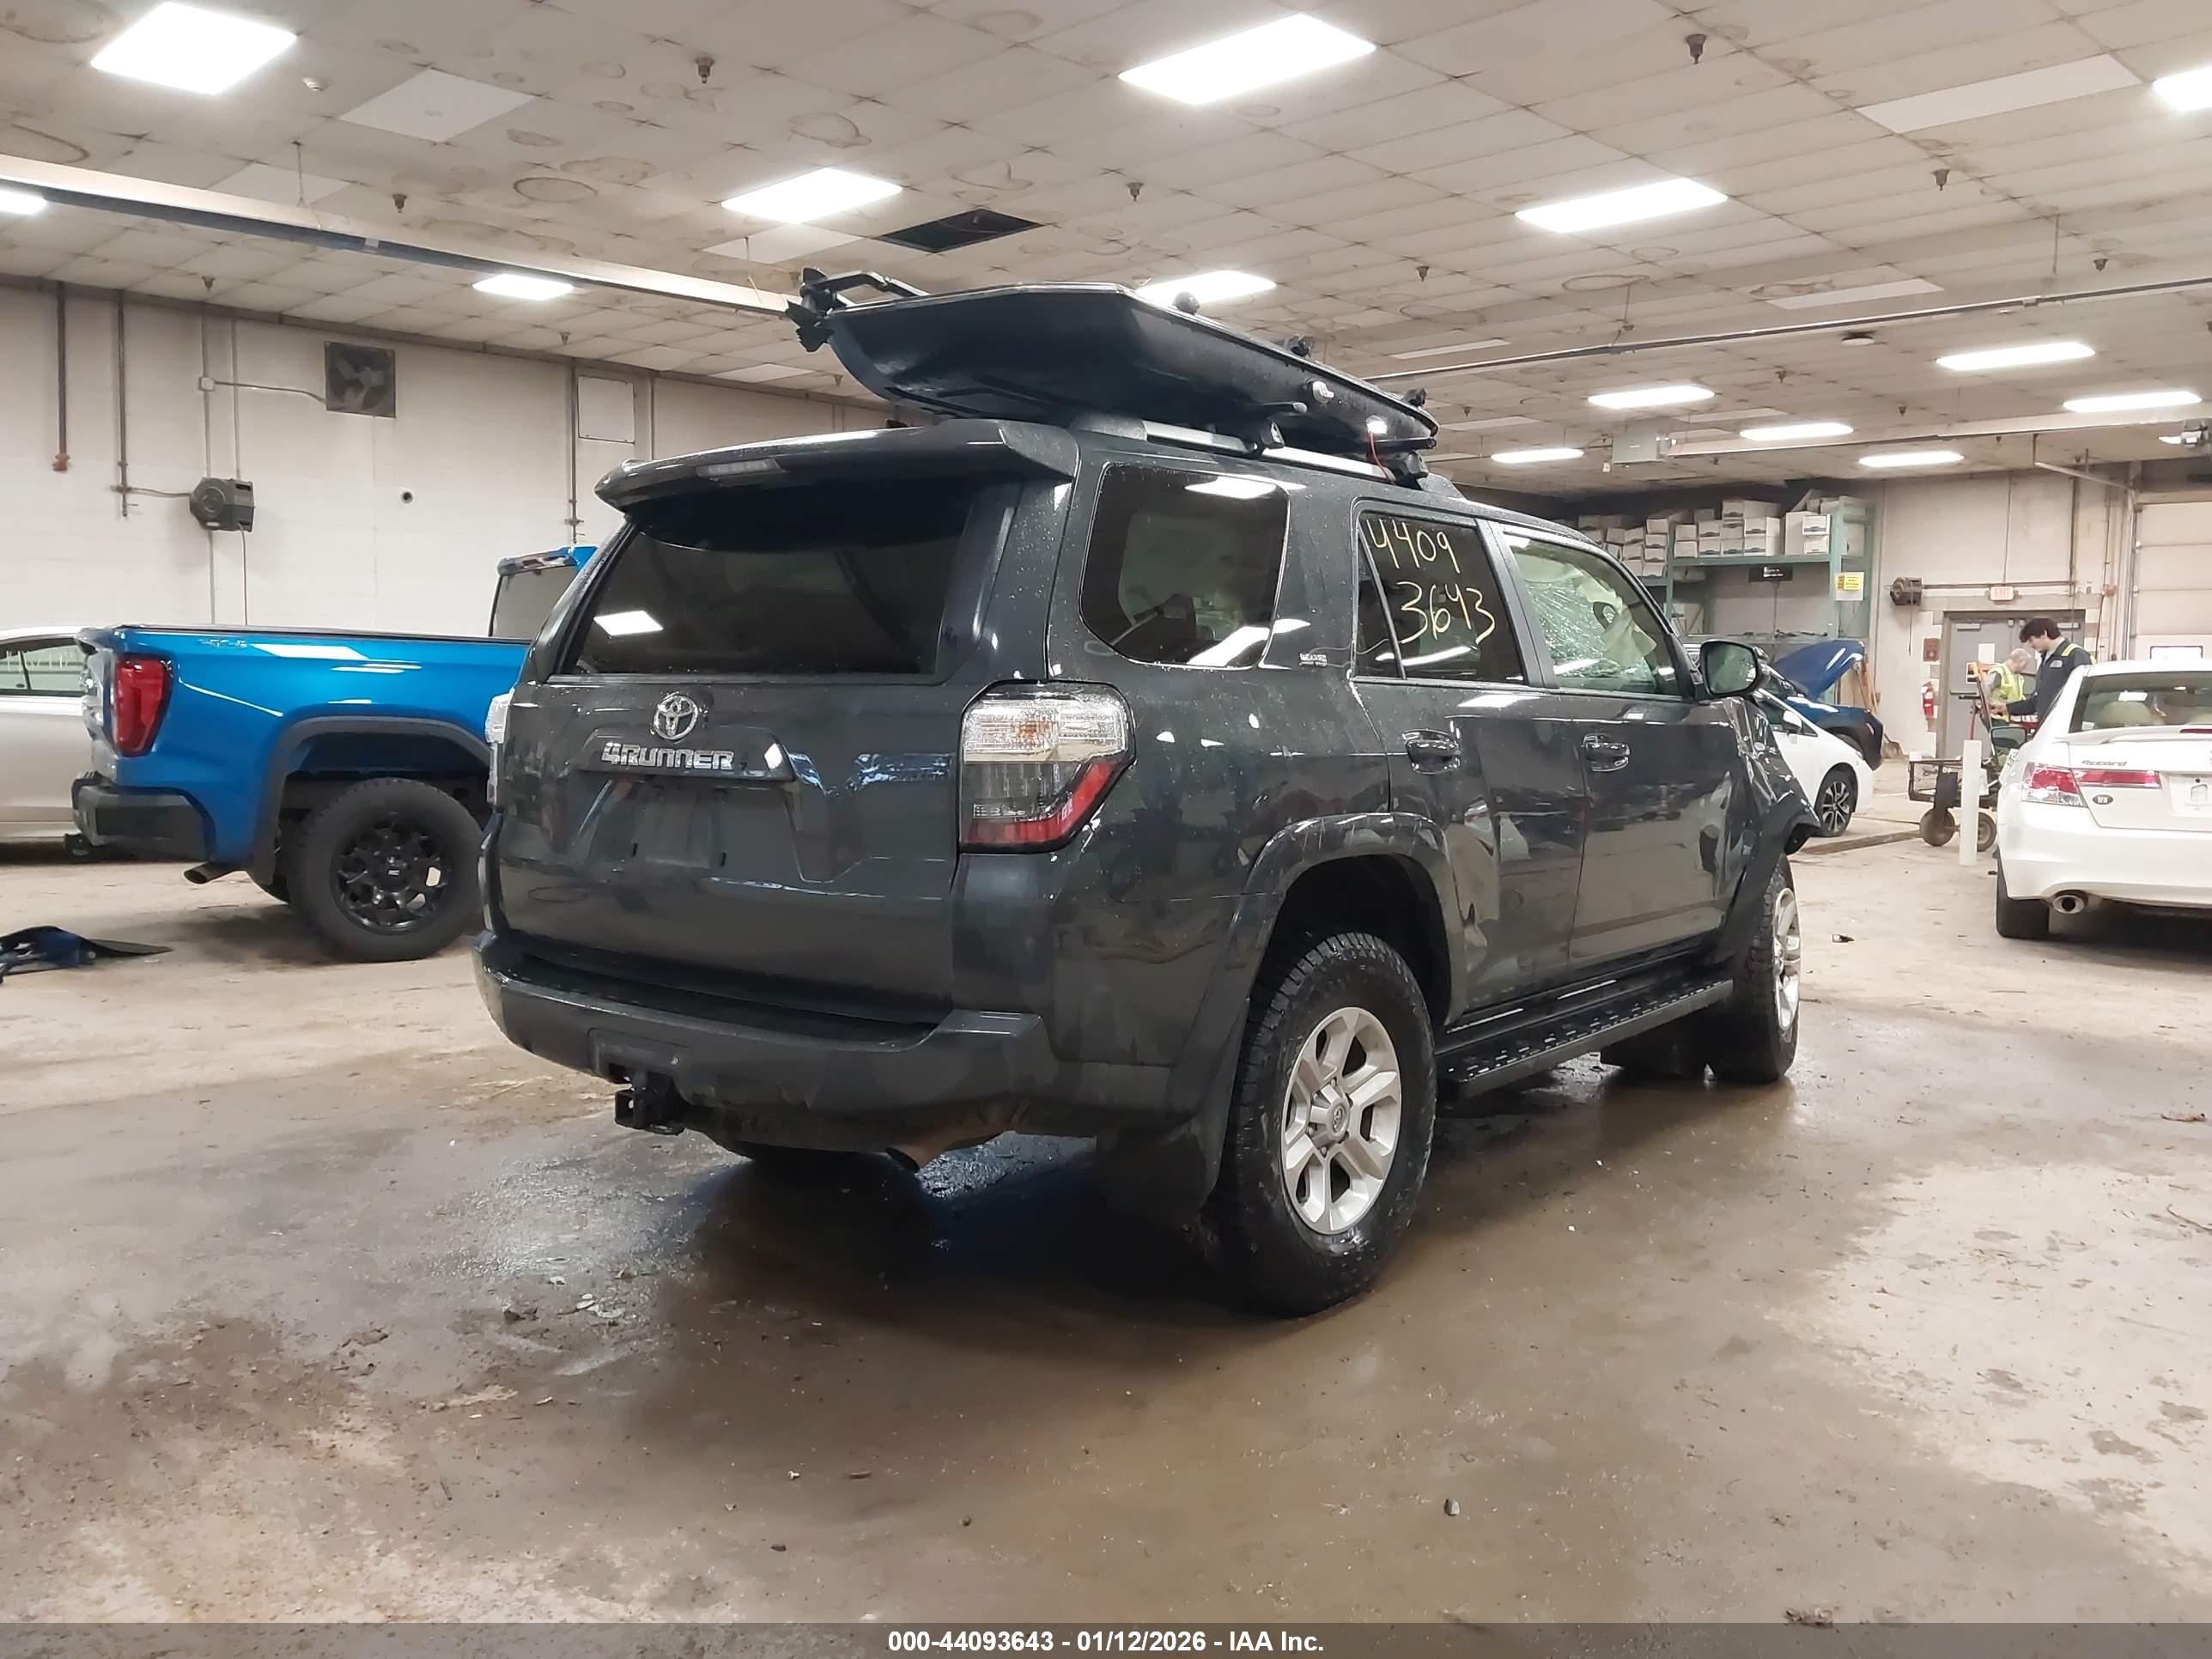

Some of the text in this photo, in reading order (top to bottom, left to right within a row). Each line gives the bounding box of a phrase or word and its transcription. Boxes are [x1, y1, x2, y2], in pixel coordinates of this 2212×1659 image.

[1366, 519, 1461, 574] 4409
[1396, 581, 1496, 645] 3643
[601, 741, 734, 770] 4RUNNER
